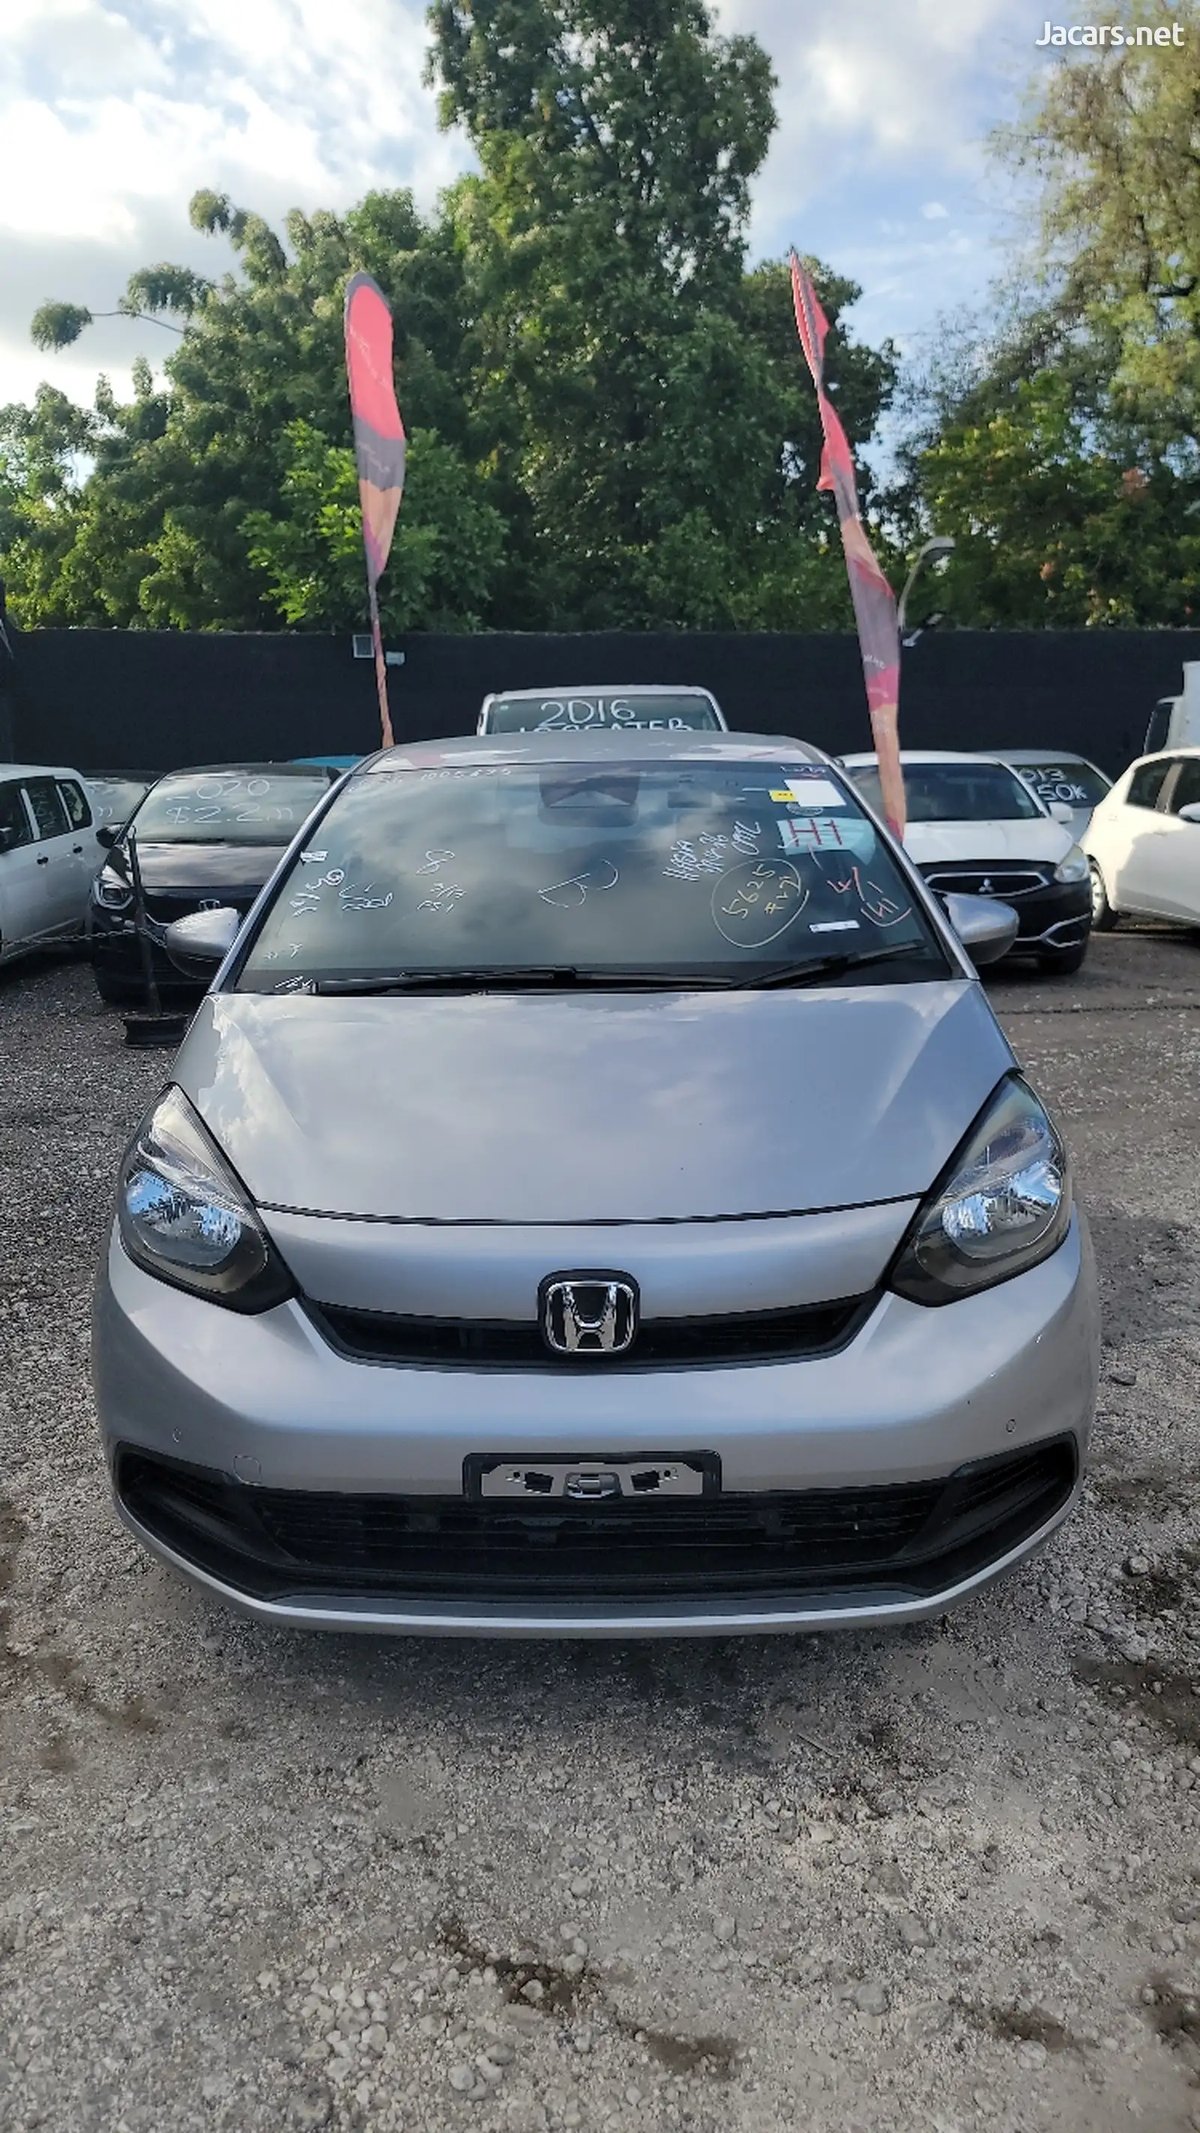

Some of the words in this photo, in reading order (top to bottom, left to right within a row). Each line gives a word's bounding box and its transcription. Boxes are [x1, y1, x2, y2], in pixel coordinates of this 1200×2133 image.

[539, 699, 636, 727] 2016
[1019, 767, 1068, 783] 013
[165, 778, 270, 801] 020
